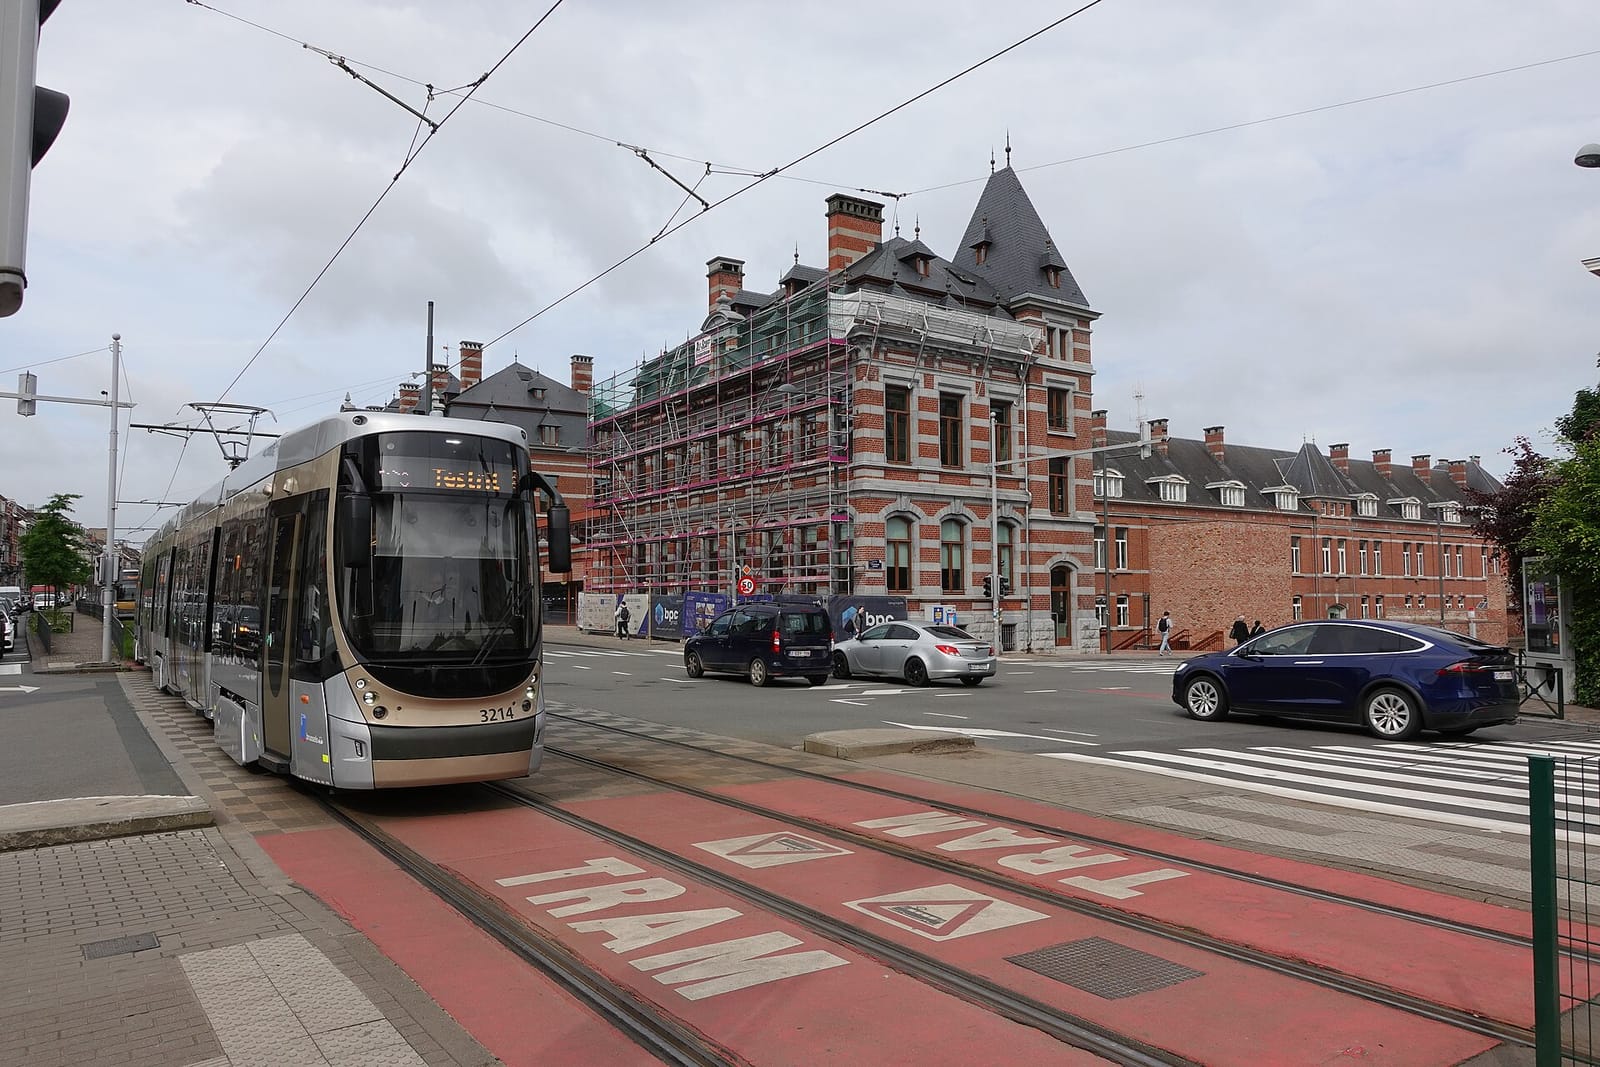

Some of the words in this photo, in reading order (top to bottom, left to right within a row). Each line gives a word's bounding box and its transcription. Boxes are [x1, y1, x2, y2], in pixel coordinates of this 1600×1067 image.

[664, 607, 679, 622] bpc
[480, 706, 514, 722] 3214
[854, 811, 1191, 899] TRAM
[495, 857, 851, 1001] TRAM
